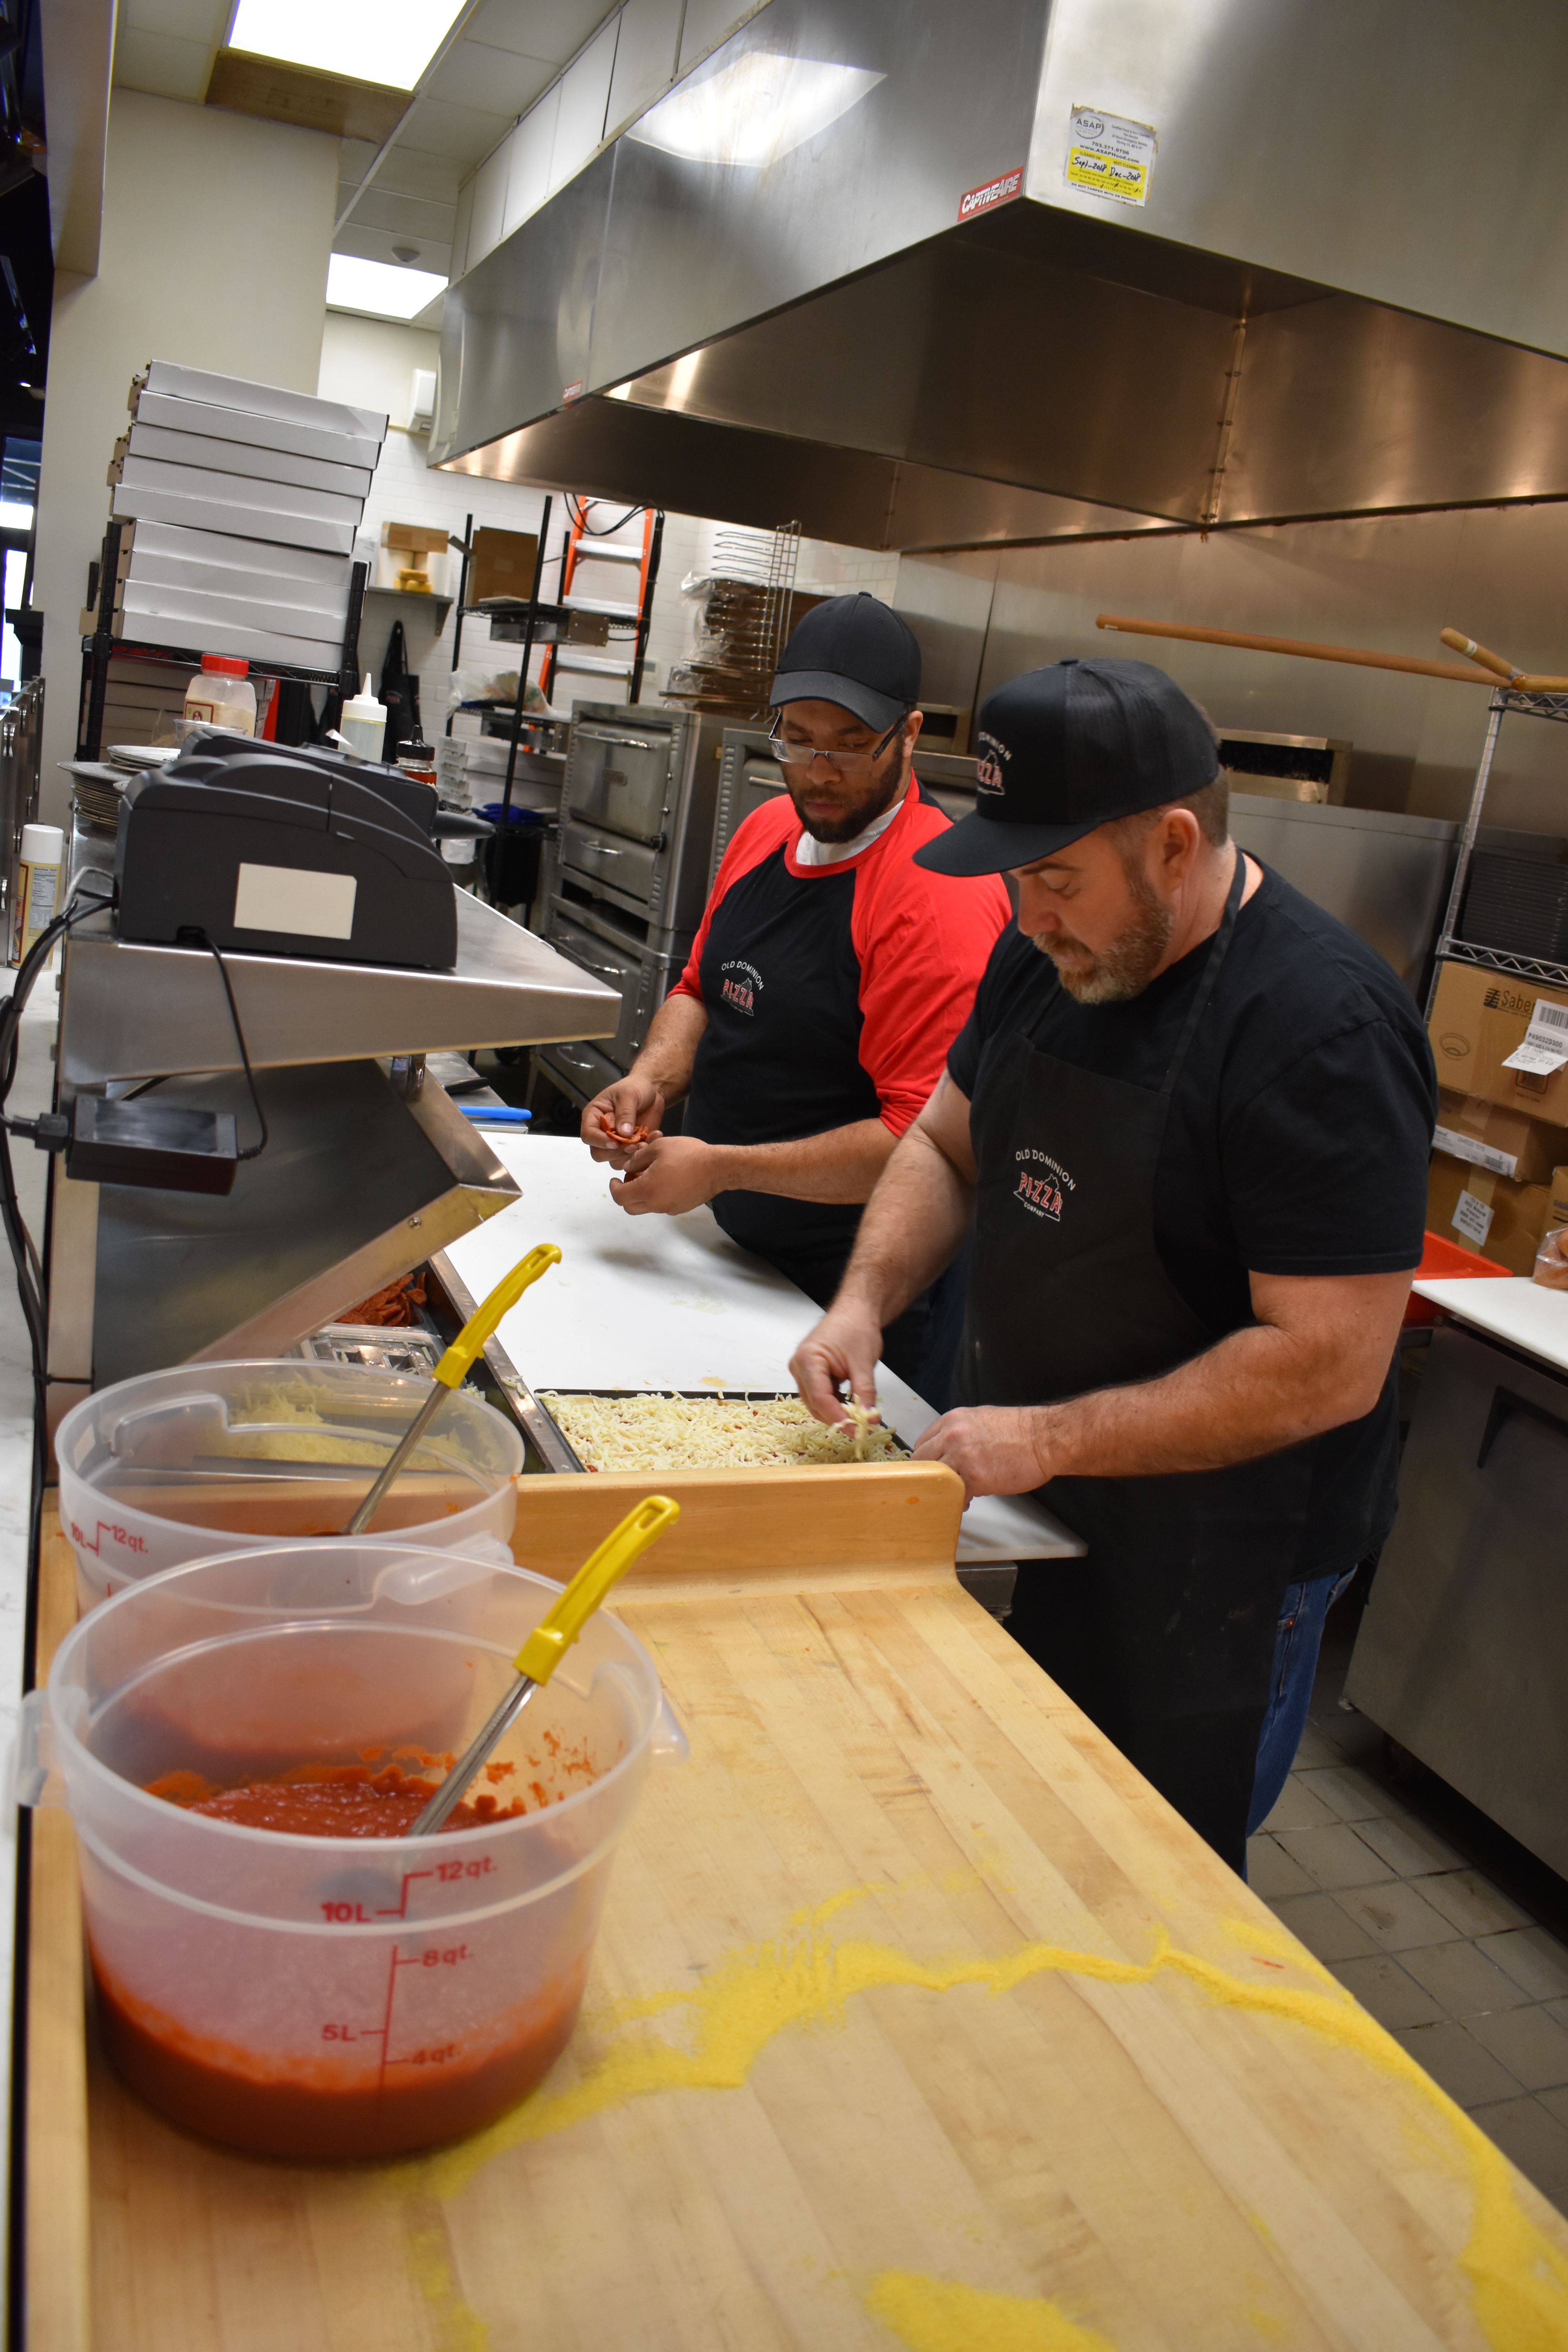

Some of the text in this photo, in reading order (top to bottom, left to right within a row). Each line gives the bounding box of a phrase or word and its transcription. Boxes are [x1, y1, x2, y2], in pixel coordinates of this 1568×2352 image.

[1076, 119, 1101, 129] ASAP
[1080, 144, 1139, 163] www.ASAPHood.com
[1092, 141, 1129, 155] 703.371.9706
[1109, 167, 1141, 181] Dec-2018
[722, 961, 764, 991] OLD DOMINION
[723, 979, 753, 1010] PIZZA
[1016, 1149, 1076, 1191] OLD DOMINION
[1019, 1171, 1061, 1214] PIZZA
[1024, 1201, 1045, 1218] COMPANY
[112, 1525, 149, 1554] 12qt.
[436, 1856, 498, 1882] 12qt.
[321, 1901, 373, 1922] 10L
[422, 1944, 473, 1968] 8qt.
[321, 2024, 357, 2042] 5L
